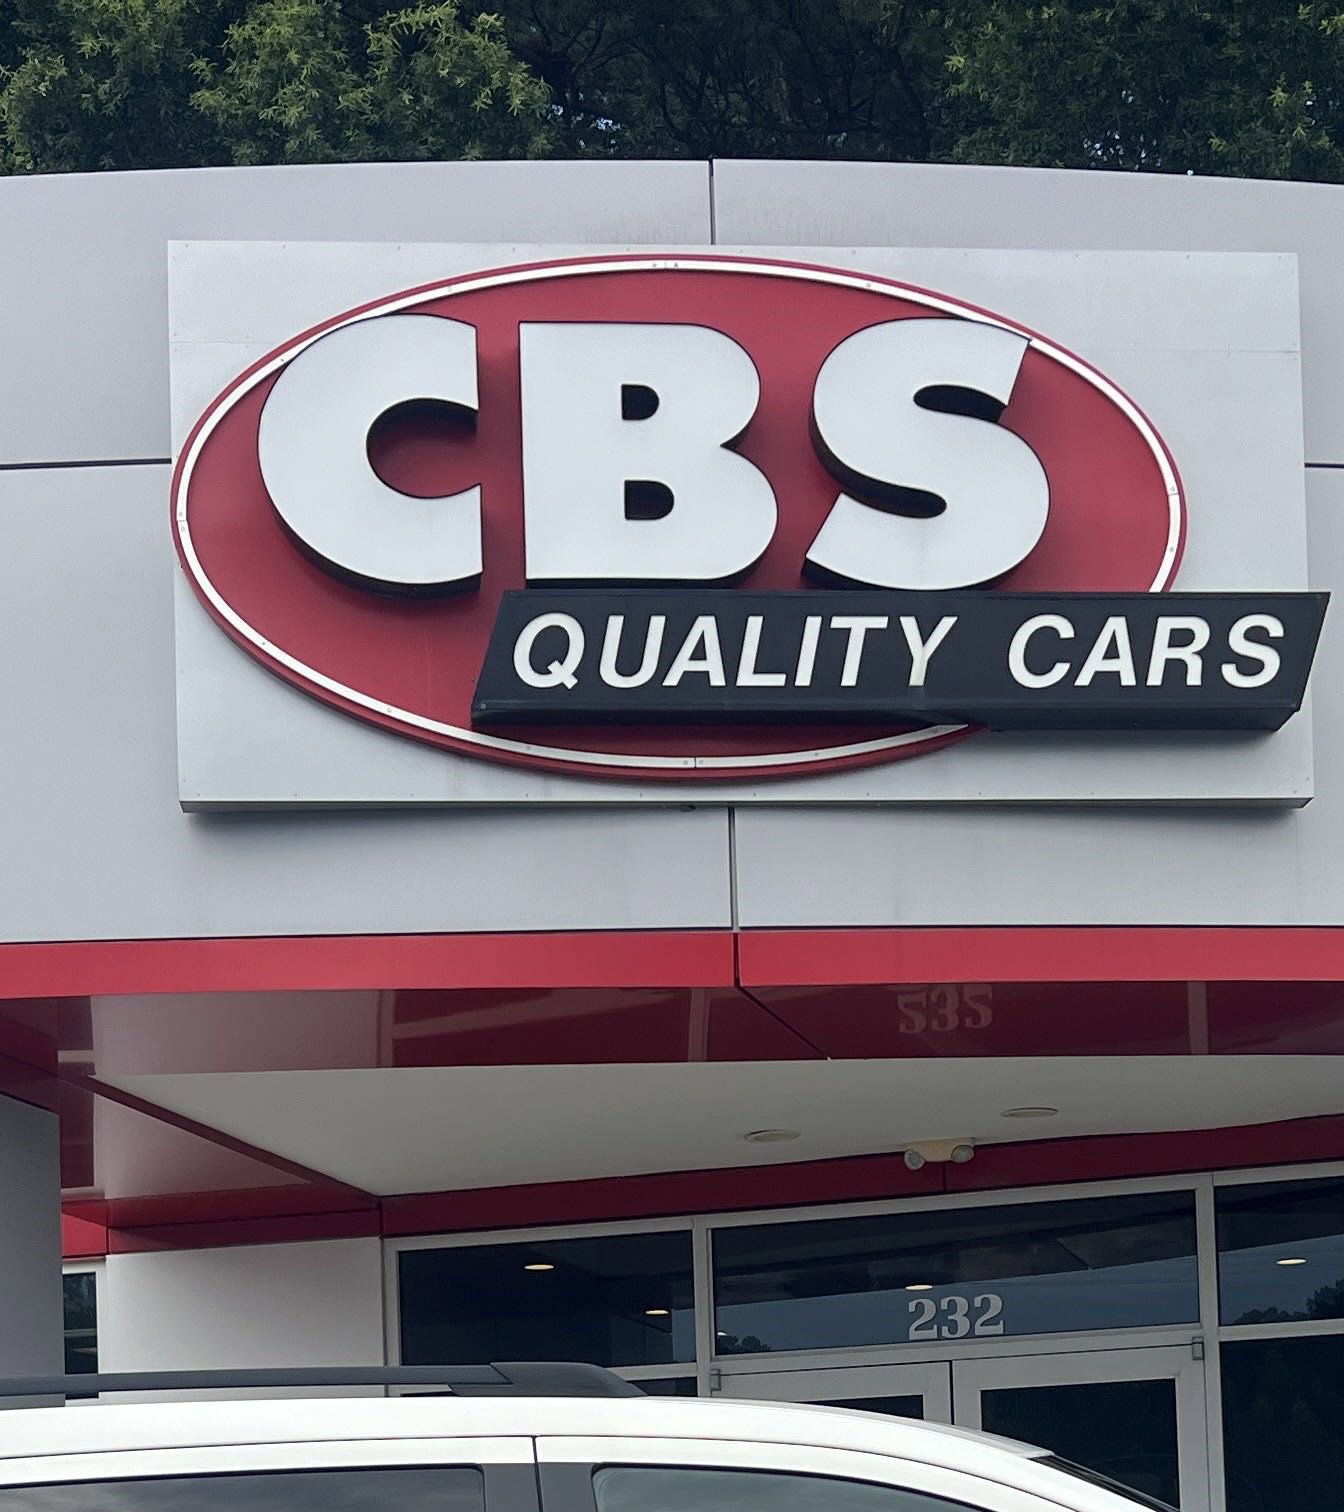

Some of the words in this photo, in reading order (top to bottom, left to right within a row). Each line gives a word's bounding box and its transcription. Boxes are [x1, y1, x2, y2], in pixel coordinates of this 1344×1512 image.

[257, 312, 1051, 592] CBS
[511, 610, 958, 692] QUALITY
[1007, 610, 1285, 691] CARS
[908, 1293, 1004, 1340] 232
